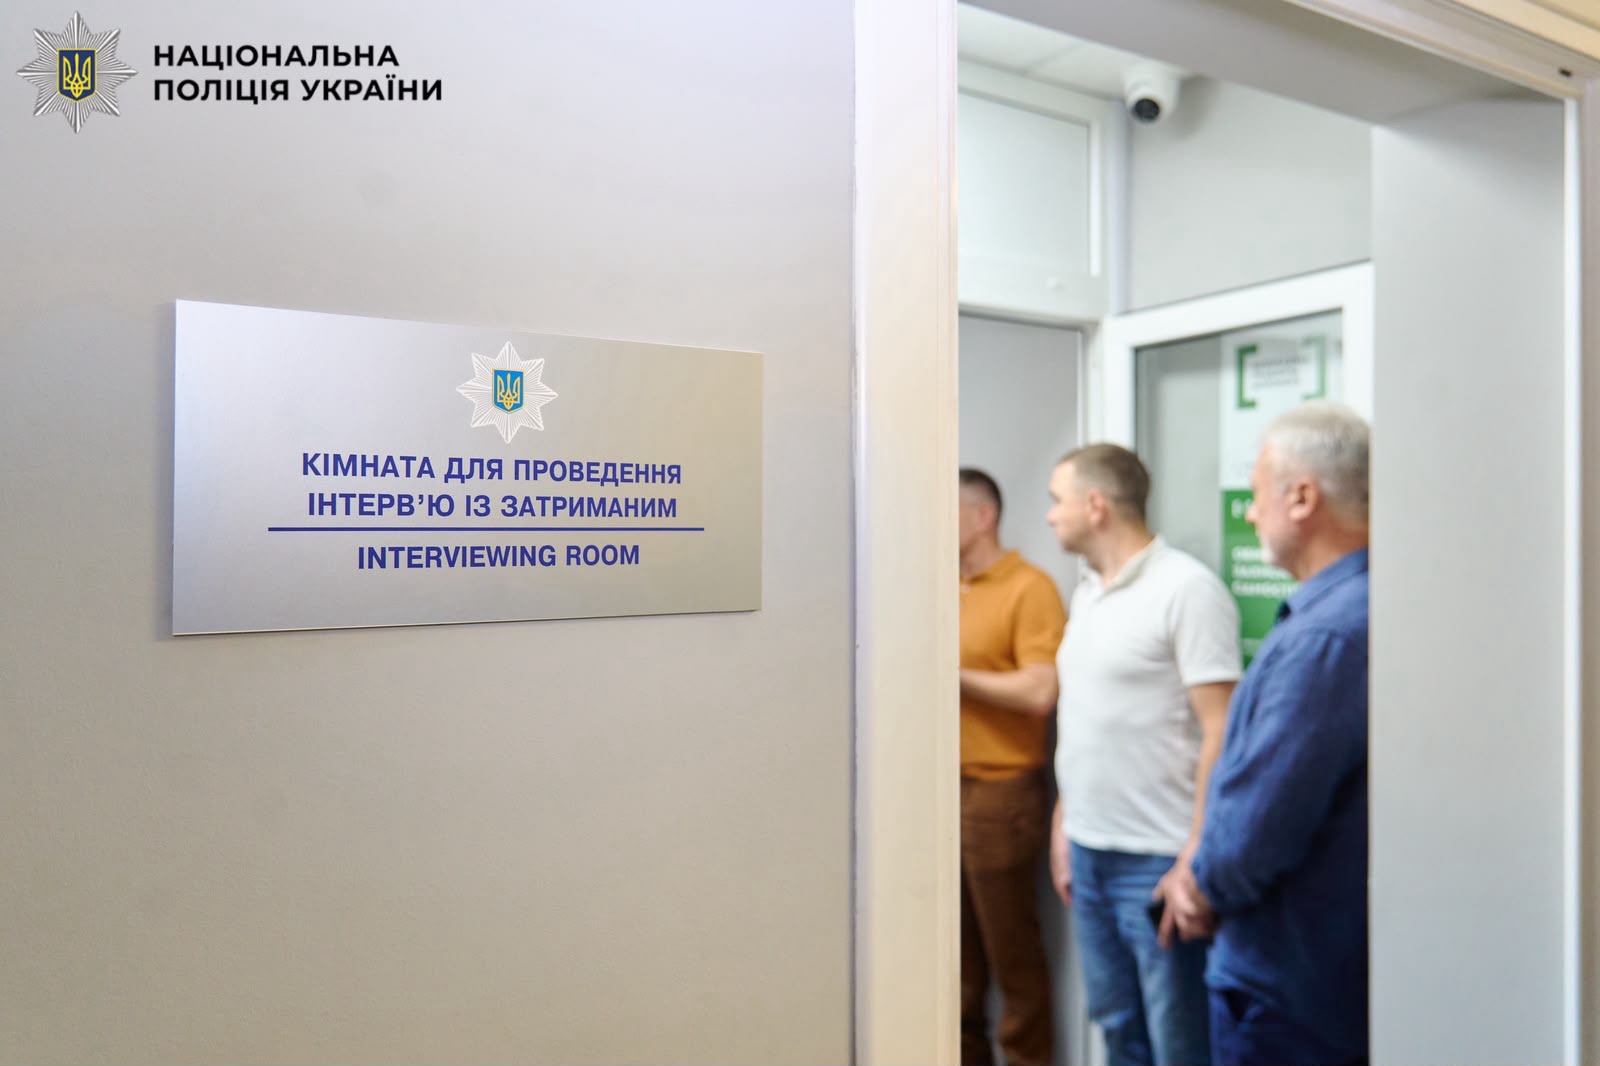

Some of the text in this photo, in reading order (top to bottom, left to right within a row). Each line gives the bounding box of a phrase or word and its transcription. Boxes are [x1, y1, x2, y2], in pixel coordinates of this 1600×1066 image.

[301, 452, 682, 486] КІМНАТА ДЛЯ ПРОВЕДЕННЯ
[307, 492, 678, 519] ІНТЕРВ’Ю ІЗ ЗАТРИМАНИМ
[357, 544, 641, 570] INTERVIEWING ROOM
